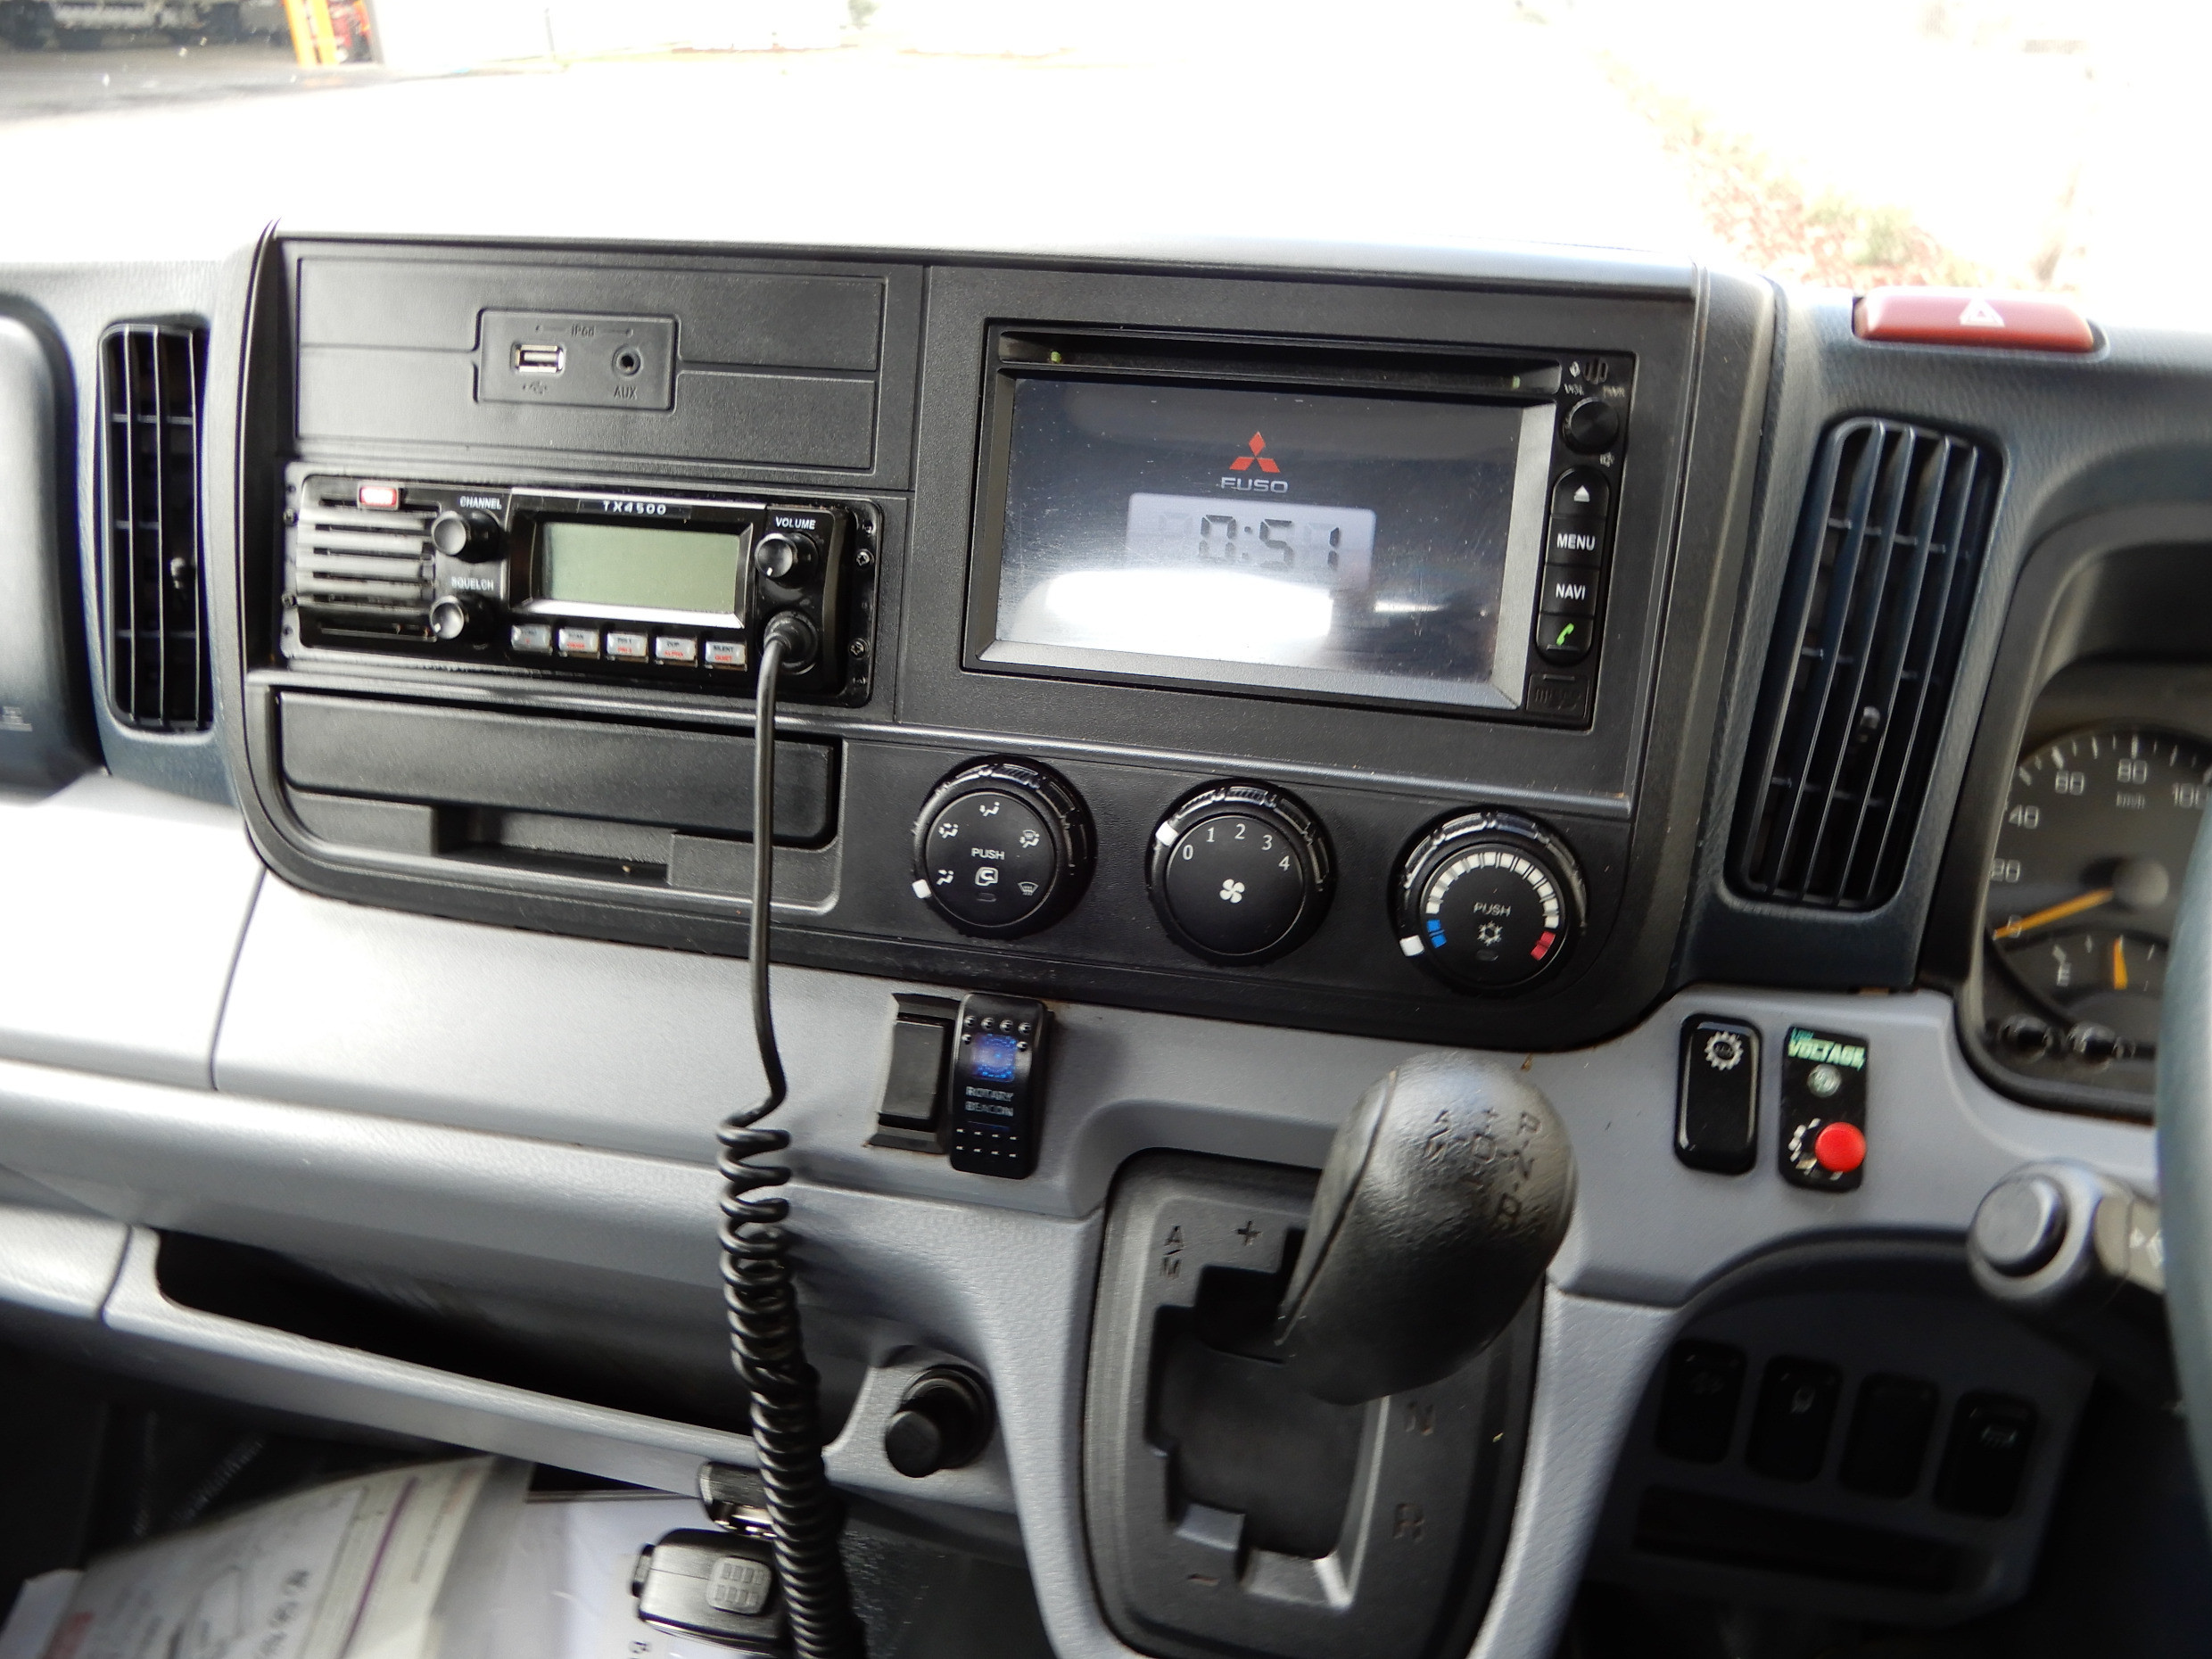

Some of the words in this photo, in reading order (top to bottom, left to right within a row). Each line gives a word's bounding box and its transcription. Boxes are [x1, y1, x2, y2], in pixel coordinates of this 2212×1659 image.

[614, 385, 638, 400] AUX
[1220, 476, 1288, 493] FUSO
[459, 496, 502, 510] CHANNEL
[603, 500, 667, 516] TX4500
[775, 516, 816, 530] VOLUME
[1556, 533, 1596, 551] MENU
[451, 576, 494, 590] SQUELCH
[1556, 583, 1586, 600] NAVI
[2009, 804, 2040, 830] 40
[971, 847, 1005, 860] PUSH
[1182, 844, 1194, 861] 0
[1206, 827, 1215, 843] 1
[1234, 823, 1246, 840] 2
[1261, 834, 1273, 851] 3
[1278, 855, 1291, 871] 4
[1473, 902, 1512, 917] PUSH
[965, 1085, 1014, 1102] ROTARY
[965, 1101, 1014, 1117] BEACON
